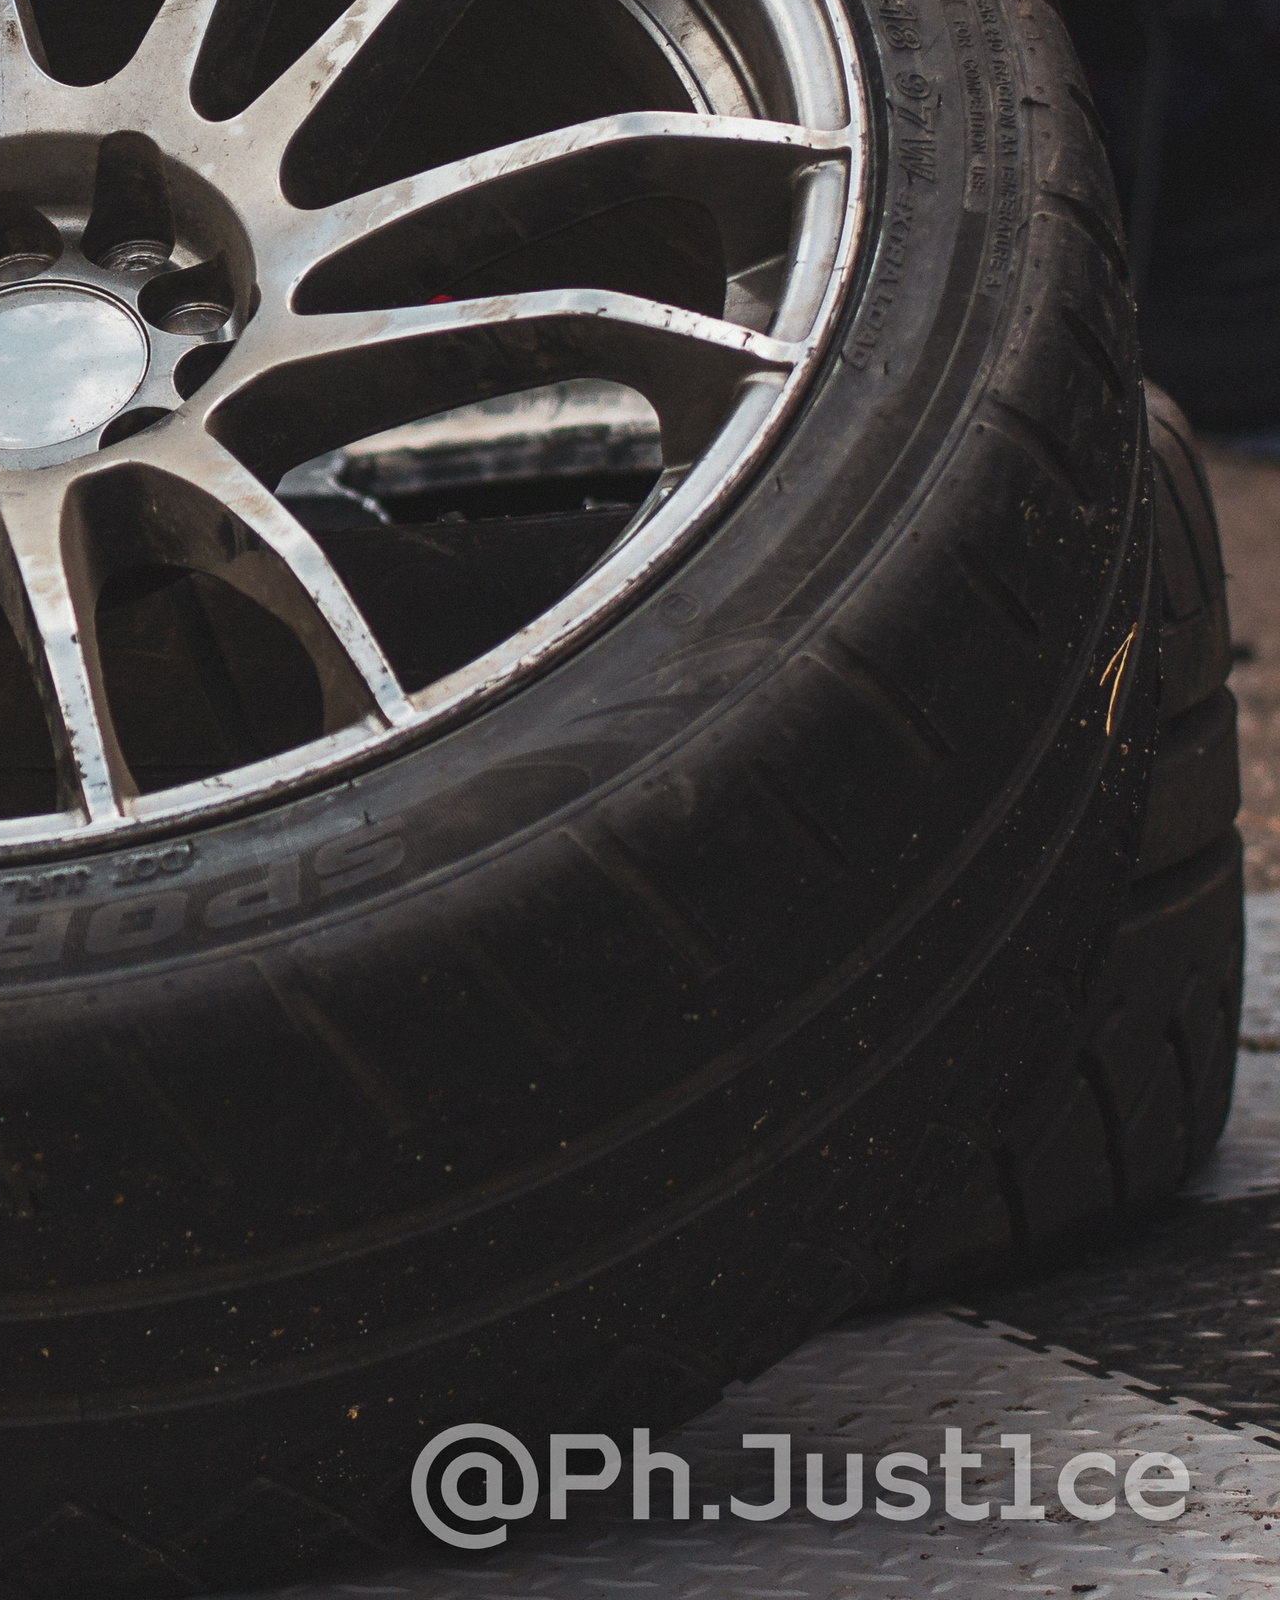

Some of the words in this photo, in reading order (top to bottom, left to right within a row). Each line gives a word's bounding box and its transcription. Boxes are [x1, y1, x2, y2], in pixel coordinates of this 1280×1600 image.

[951, 17, 975, 51] FOR
[960, 57, 986, 156] COMPETITION
[991, 56, 1016, 131] TRACTION
[969, 165, 987, 192] USE
